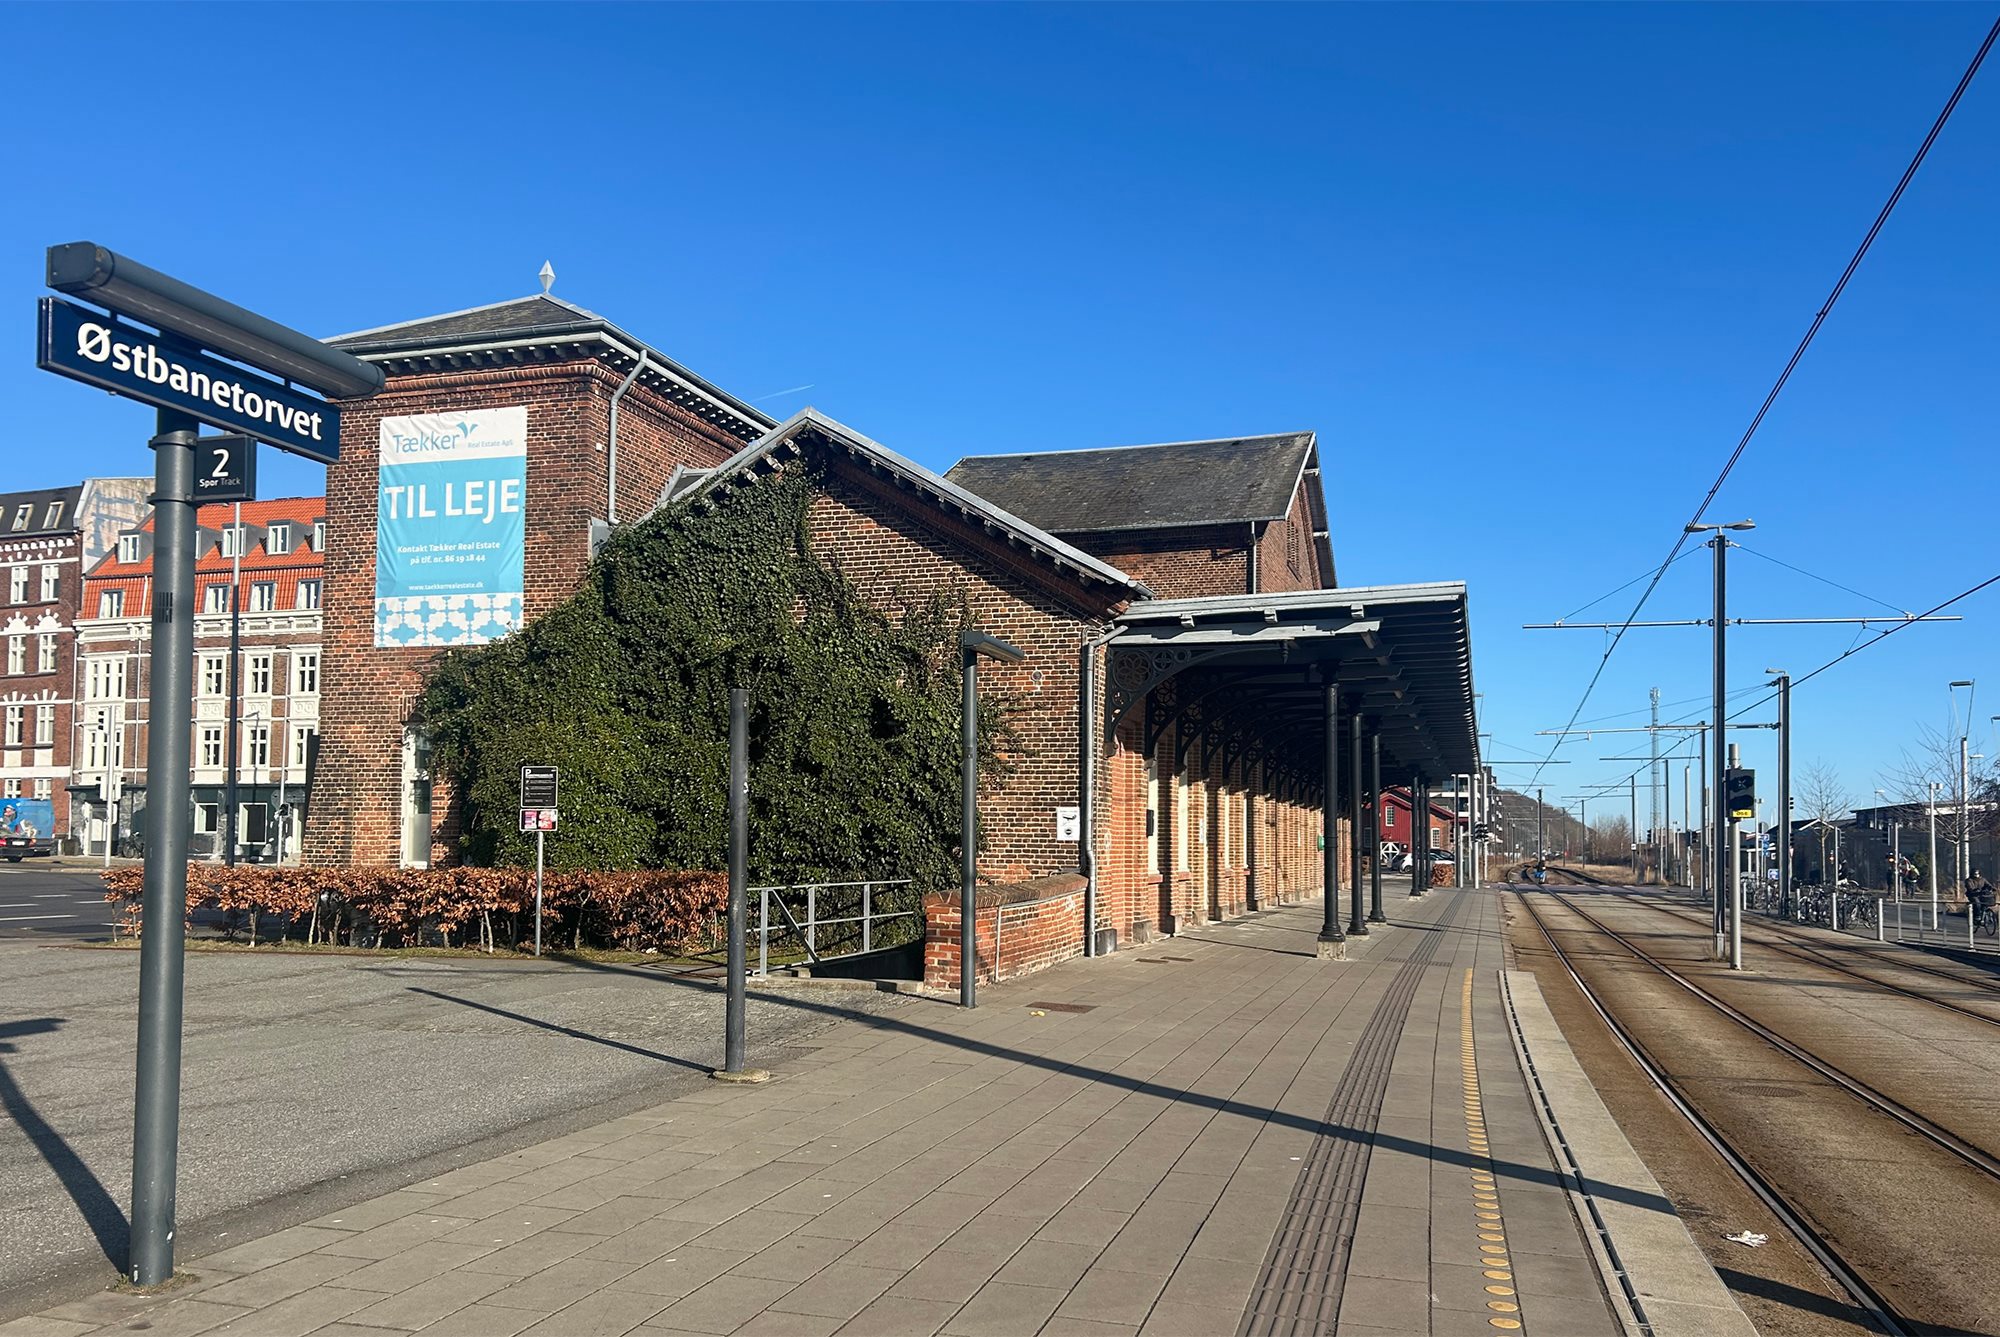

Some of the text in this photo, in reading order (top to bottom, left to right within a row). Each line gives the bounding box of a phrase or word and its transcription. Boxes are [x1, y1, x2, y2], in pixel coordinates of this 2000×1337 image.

[76, 322, 322, 441] Østbanetorvet
[392, 431, 460, 453] Tækker
[212, 449, 229, 477] 2
[199, 477, 241, 488] Spor Track
[384, 479, 520, 524] TIL LEJE
[397, 541, 500, 553] Kontakt Tækker Real Estate
[410, 556, 420, 566] på
[475, 554, 486, 562] 44
